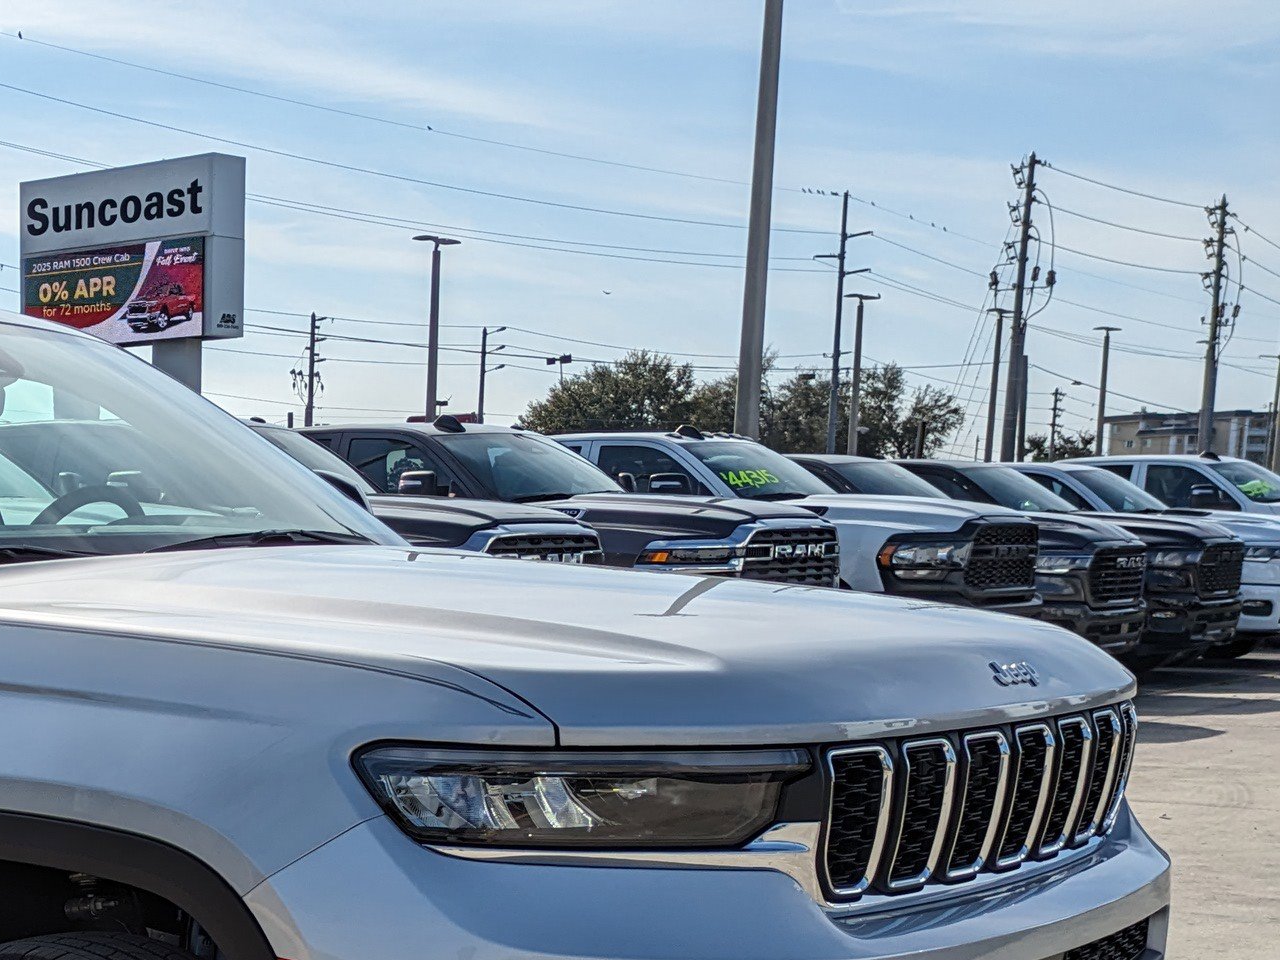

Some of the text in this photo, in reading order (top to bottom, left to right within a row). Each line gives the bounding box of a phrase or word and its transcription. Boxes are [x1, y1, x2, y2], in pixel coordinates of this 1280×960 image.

[27, 178, 203, 236] Suncoast
[32, 252, 130, 273] 2025 RAM 1500 Crew Cab
[38, 275, 116, 303] 0% APR
[42, 301, 112, 317] for 72 months
[775, 544, 823, 559] RAM
[988, 659, 1041, 687] Jeep
